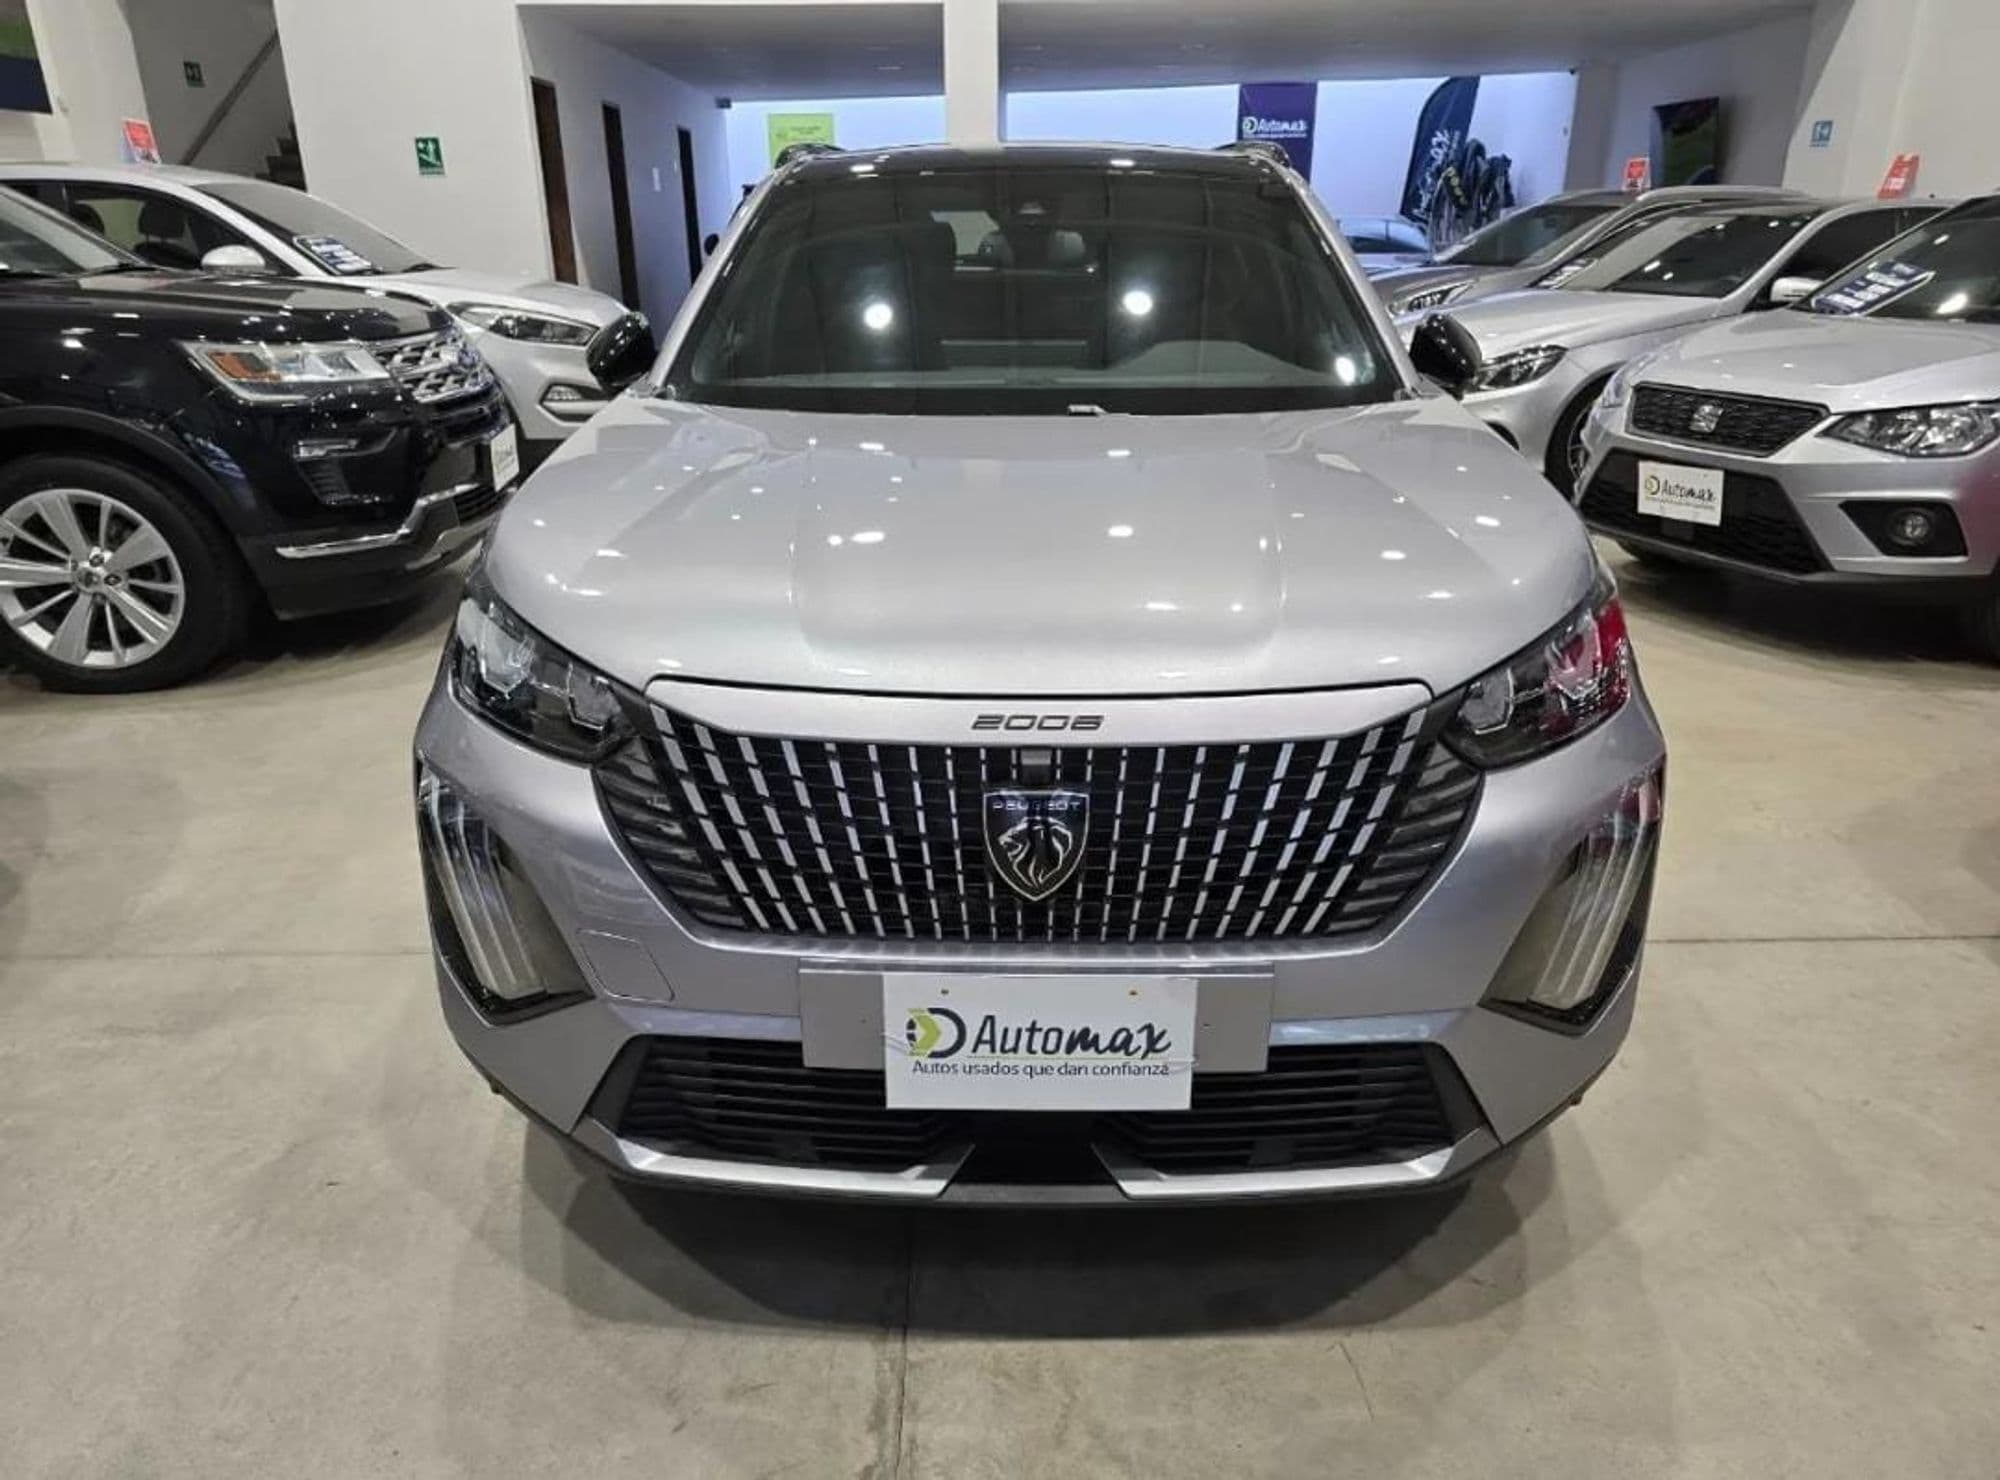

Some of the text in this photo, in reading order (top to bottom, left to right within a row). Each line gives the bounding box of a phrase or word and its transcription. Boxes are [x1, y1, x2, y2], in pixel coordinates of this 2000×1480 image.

[971, 714, 1104, 731] 2008
[971, 1014, 1172, 1060] Automax
[912, 1060, 1170, 1079] Autos usados que dan confianza
